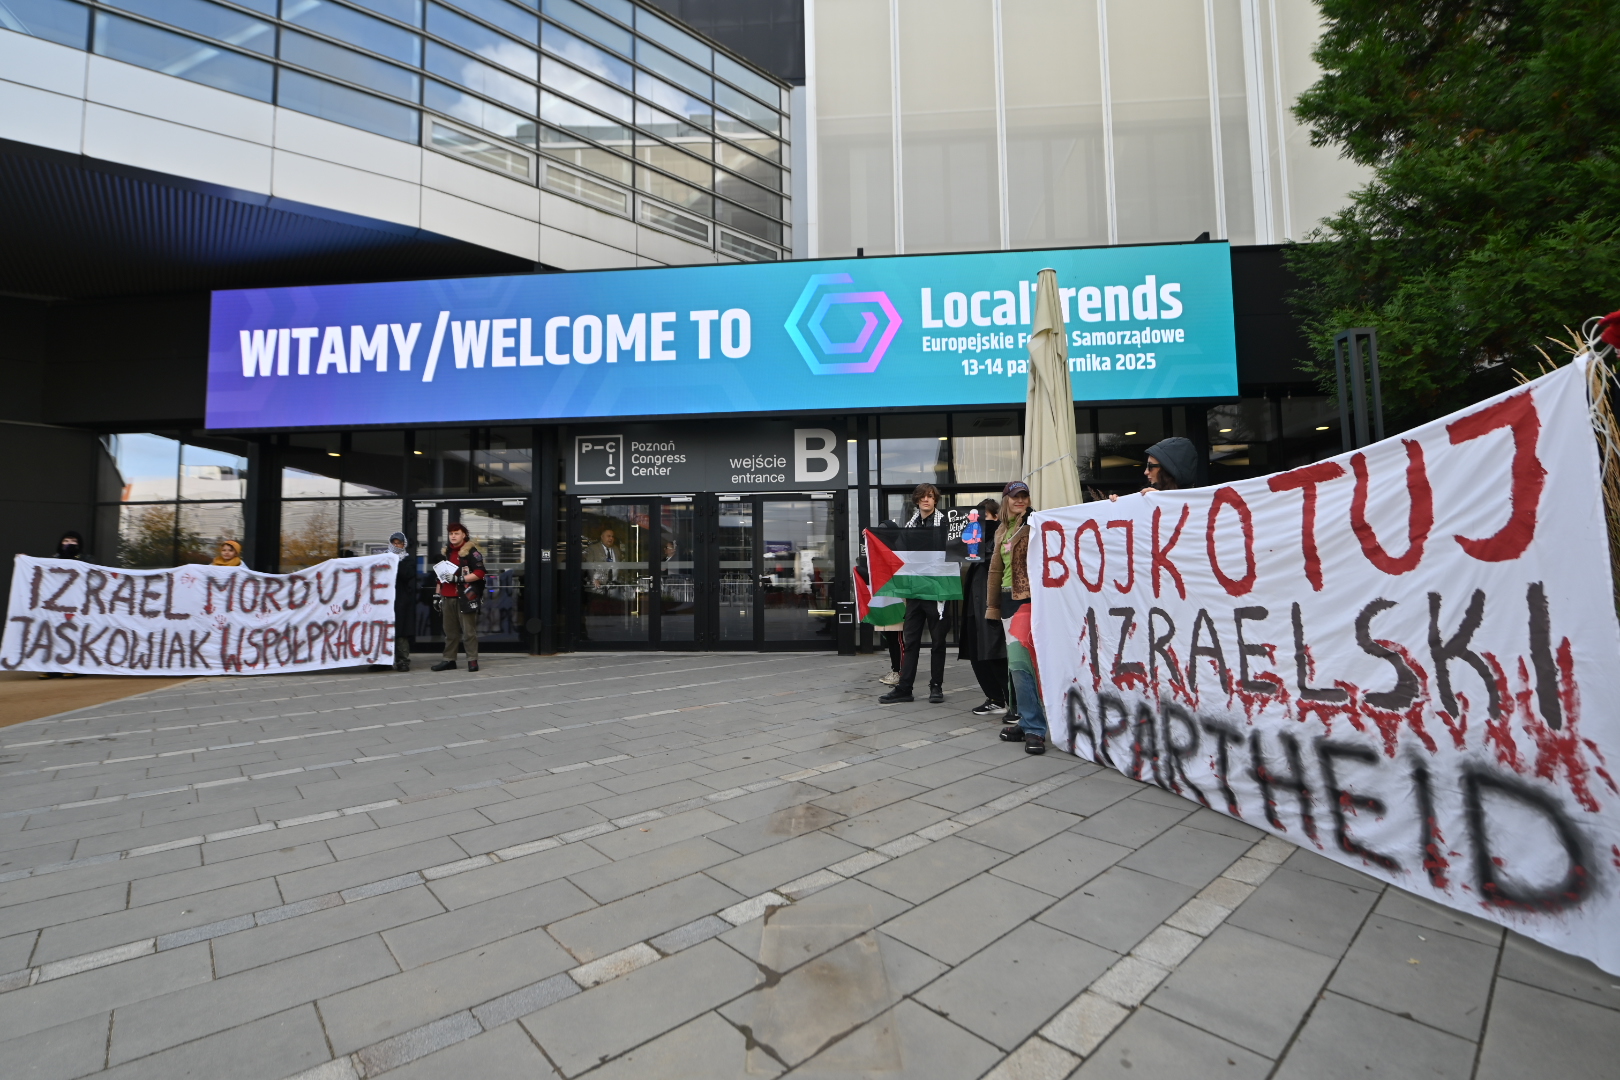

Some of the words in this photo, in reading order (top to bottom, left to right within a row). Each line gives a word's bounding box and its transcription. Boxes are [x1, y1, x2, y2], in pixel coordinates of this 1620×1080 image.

[920, 274, 1183, 329] Localrends
[239, 310, 677, 383] WITAMY/WELCOME
[690, 308, 752, 360] TO
[922, 332, 1014, 354] Europejskie
[1072, 327, 1185, 349] Samorządowe
[961, 358, 1004, 376] 13-14
[1115, 352, 1157, 371] 2025
[631, 440, 676, 452] Poznań
[631, 452, 687, 467] Congress
[729, 454, 787, 472] wejście
[793, 428, 840, 483] B
[631, 464, 672, 477] Center
[730, 472, 786, 484] entrance
[1041, 387, 1547, 601] BOJKOTUJ
[29, 564, 190, 621] IZRAEL
[205, 563, 392, 615] MORDUJE
[1083, 581, 1563, 731] IZRAELSKI
[1064, 687, 1602, 911] APARTHEID
